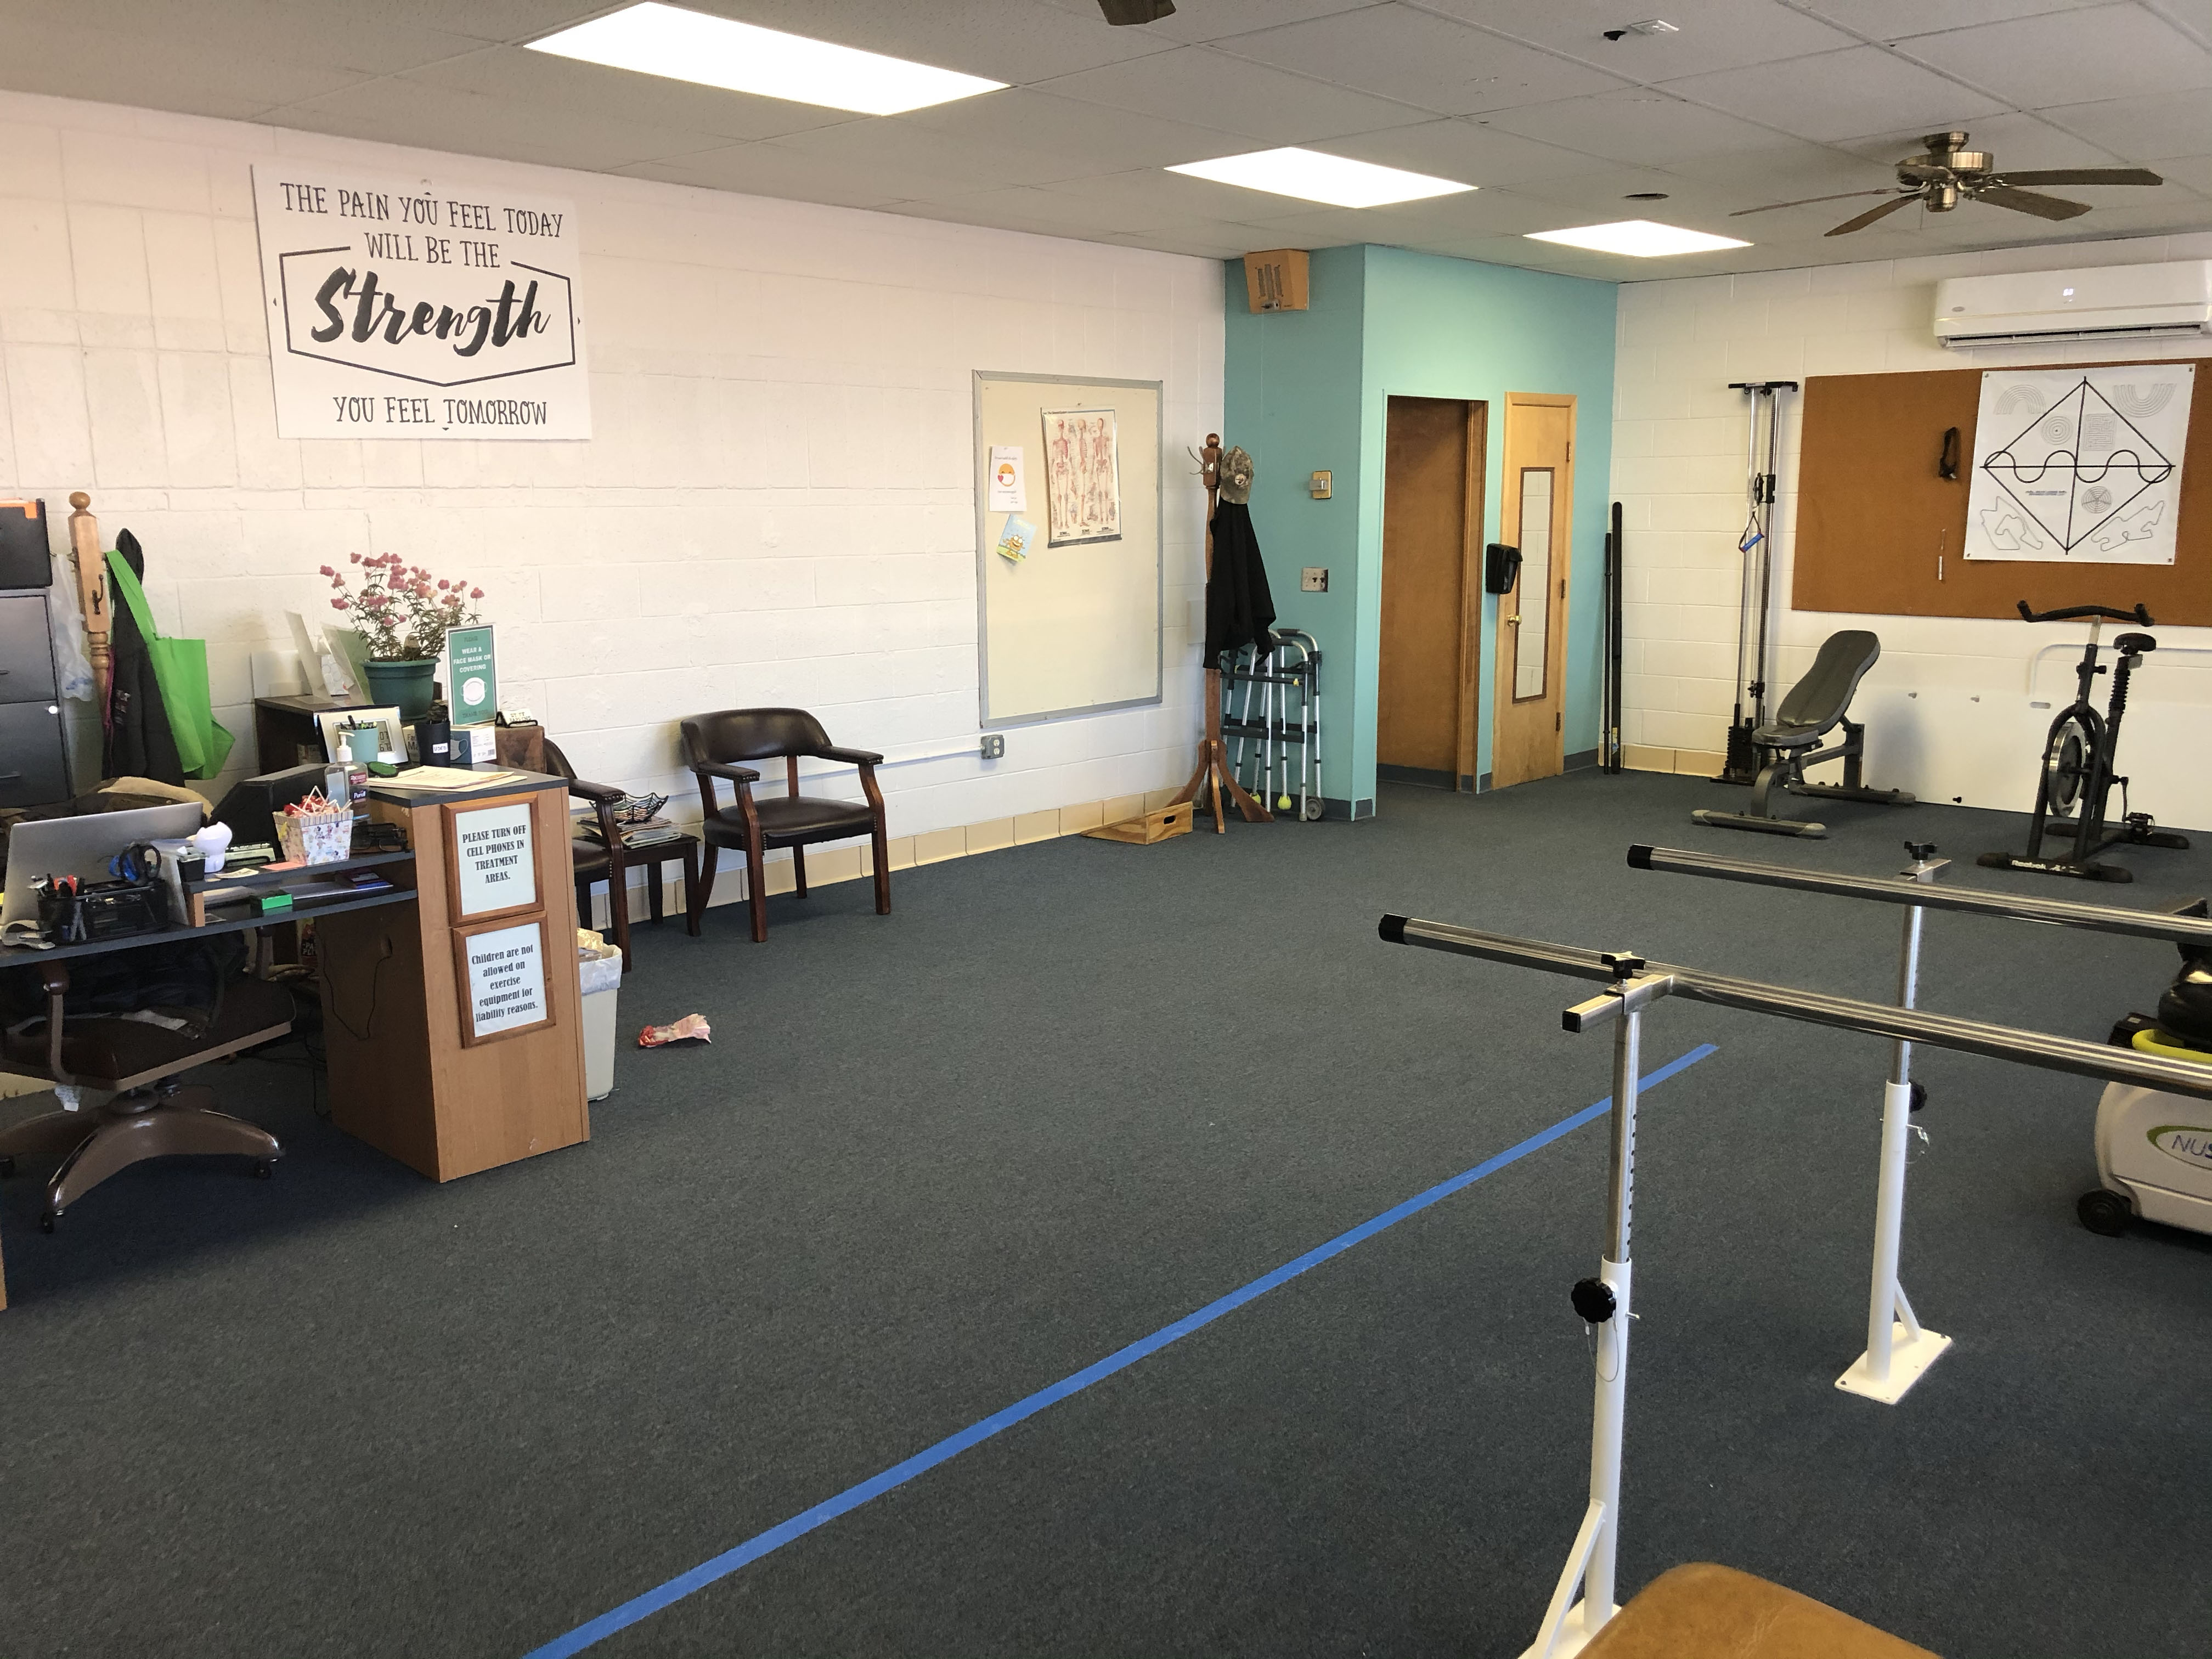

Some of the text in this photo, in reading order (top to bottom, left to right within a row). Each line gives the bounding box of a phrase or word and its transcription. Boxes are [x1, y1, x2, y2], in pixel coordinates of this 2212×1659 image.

[280, 182, 563, 238] THE PAIN YOU FEEL TODAY
[364, 232, 501, 268] WILL BE THE
[311, 266, 551, 358] Strength
[333, 396, 548, 426] YOU FEEL TOMORROW
[459, 664, 487, 673] COVERING
[467, 655, 483, 663] MASK
[462, 825, 527, 844] PLEASE TURN OFF
[466, 839, 524, 857] CELL PHONES IN
[475, 855, 518, 871] TREATMENT
[485, 871, 511, 884] AREAS.
[472, 944, 533, 965] Children are not
[483, 961, 526, 977] allowed on
[490, 976, 521, 990] exercise
[479, 988, 533, 1007] equipment for
[475, 1001, 538, 1022] liability reasons.
